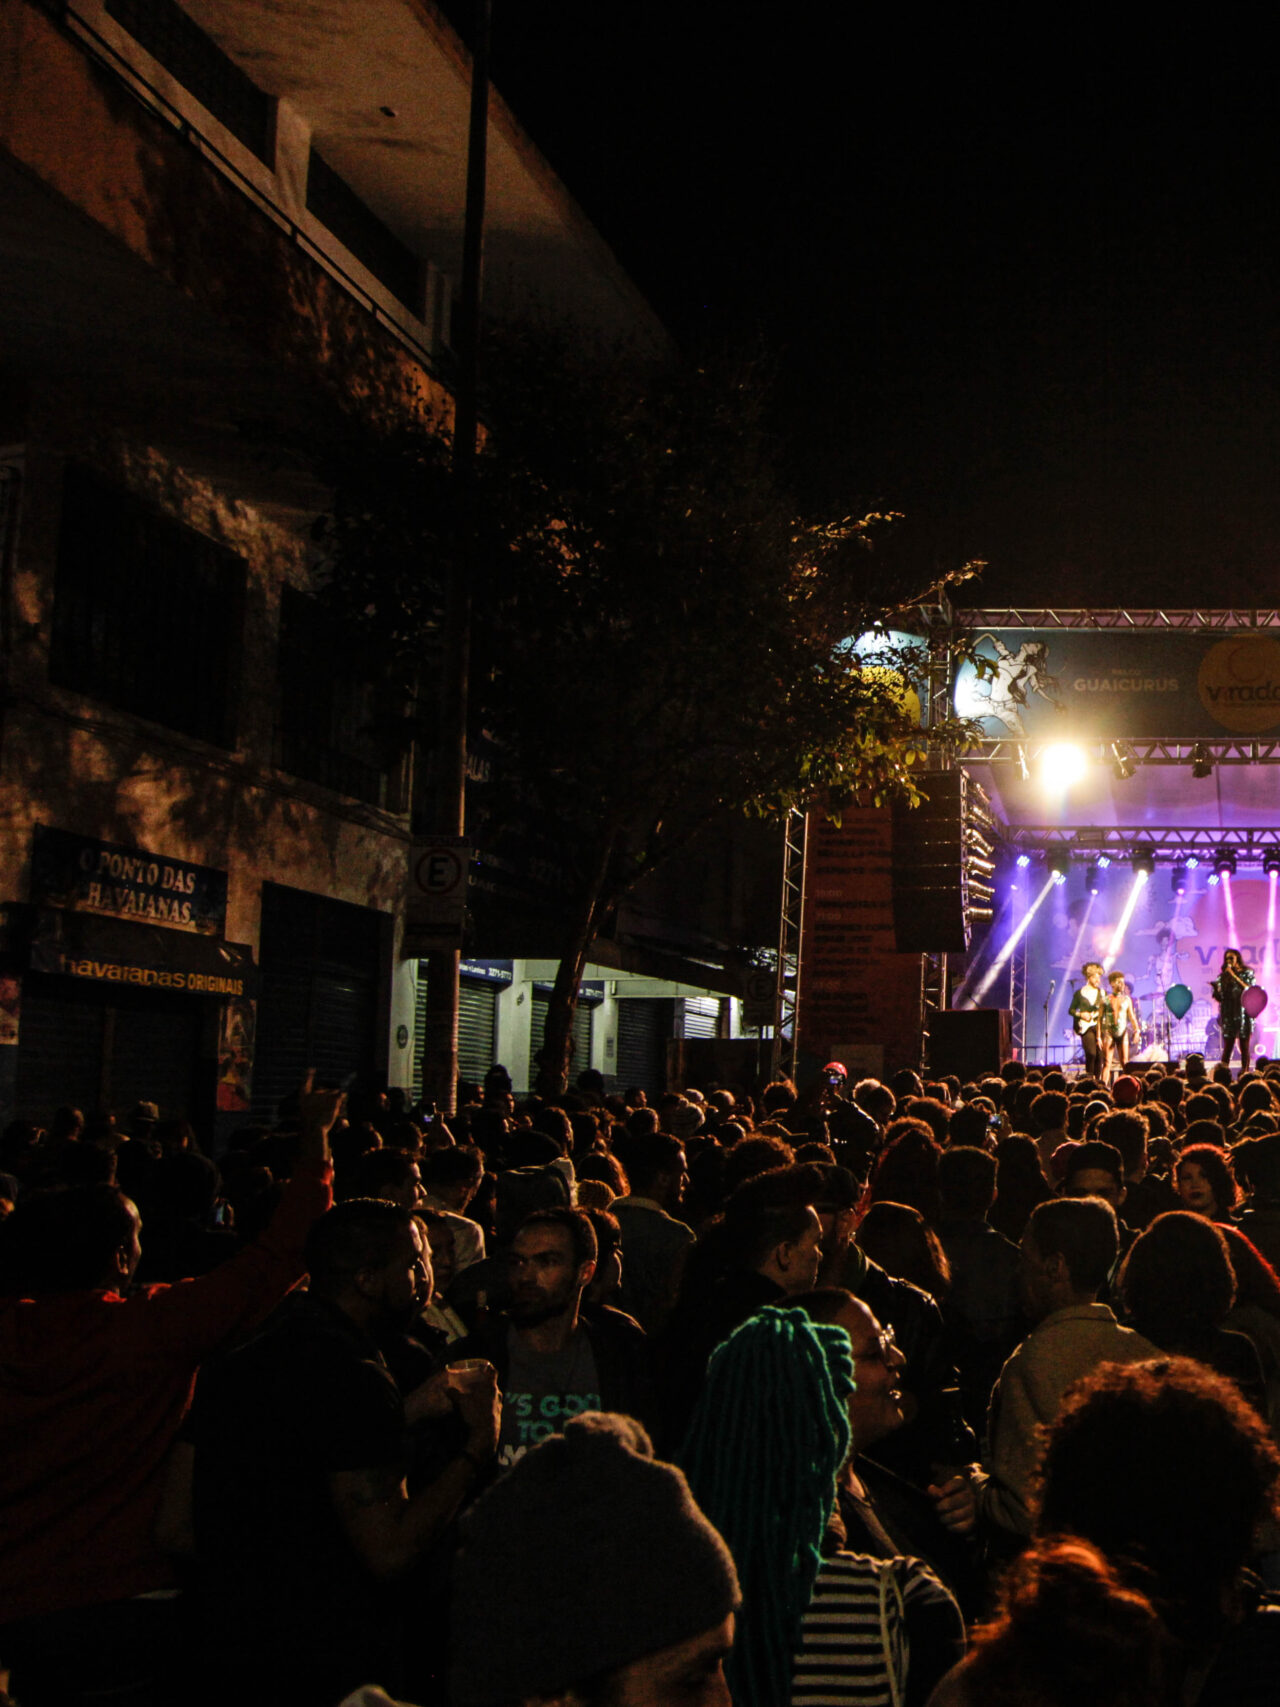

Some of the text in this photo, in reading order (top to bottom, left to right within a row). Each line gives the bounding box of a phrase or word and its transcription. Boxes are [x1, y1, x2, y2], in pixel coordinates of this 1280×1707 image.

[1073, 678, 1179, 692] GUAICURUS
[79, 848, 197, 895] O PONTO DAS
[428, 857, 449, 887] E
[187, 972, 244, 996] ORIGINAIS
